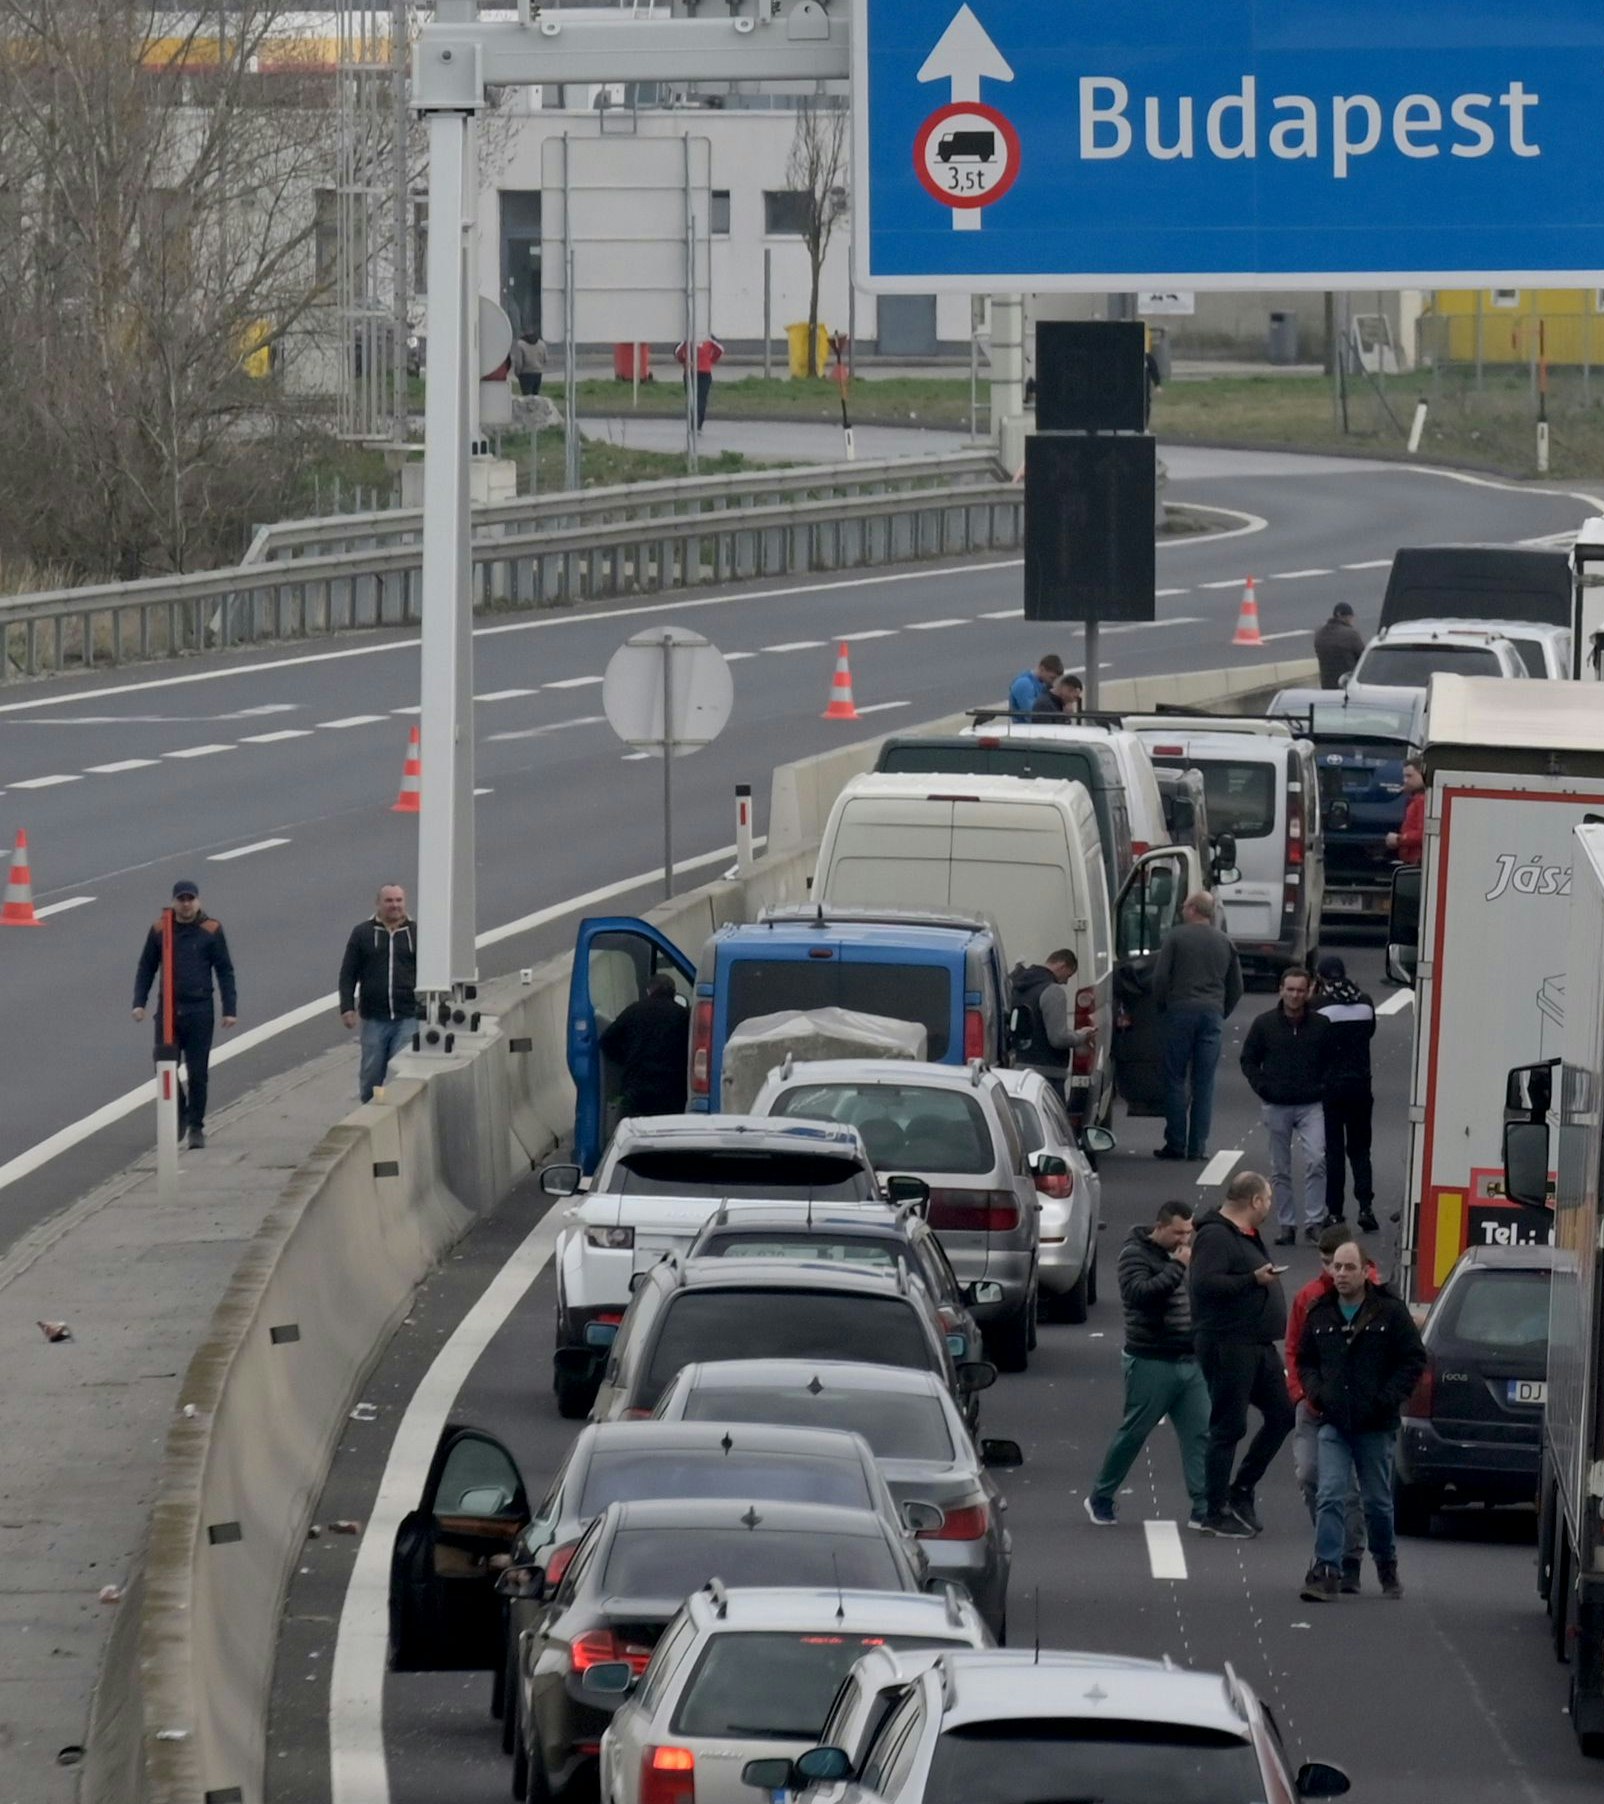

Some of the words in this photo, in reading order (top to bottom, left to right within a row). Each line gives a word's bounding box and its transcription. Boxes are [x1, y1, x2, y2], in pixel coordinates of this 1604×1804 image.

[1079, 75, 1541, 179] Budapest
[948, 166, 986, 192] 3,5t
[1520, 1383, 1542, 1400] DJ
